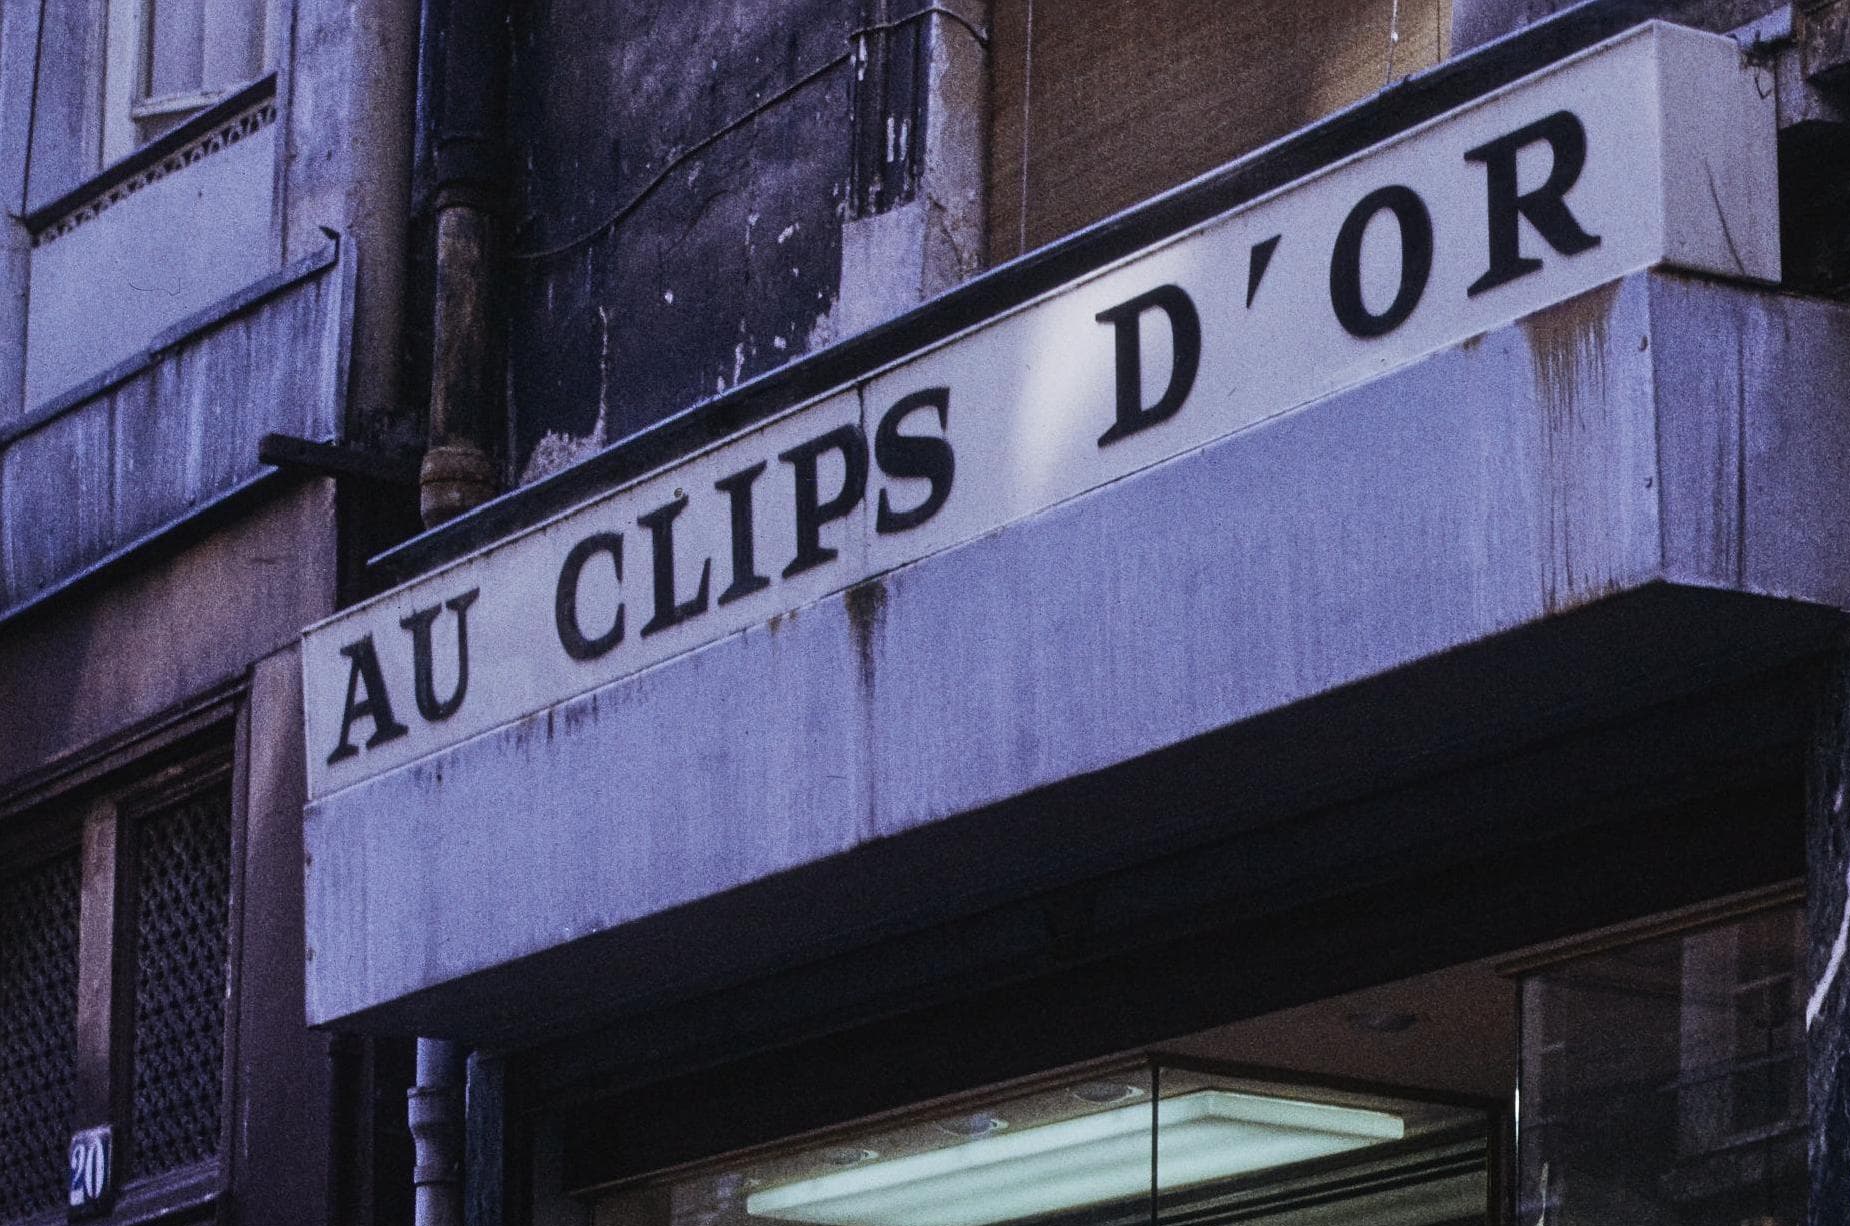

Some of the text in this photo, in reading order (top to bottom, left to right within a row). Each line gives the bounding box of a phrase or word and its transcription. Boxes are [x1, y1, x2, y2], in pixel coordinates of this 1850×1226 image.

[327, 110, 1601, 766] AU CLIPS D'OR
[70, 1136, 105, 1206] 20
